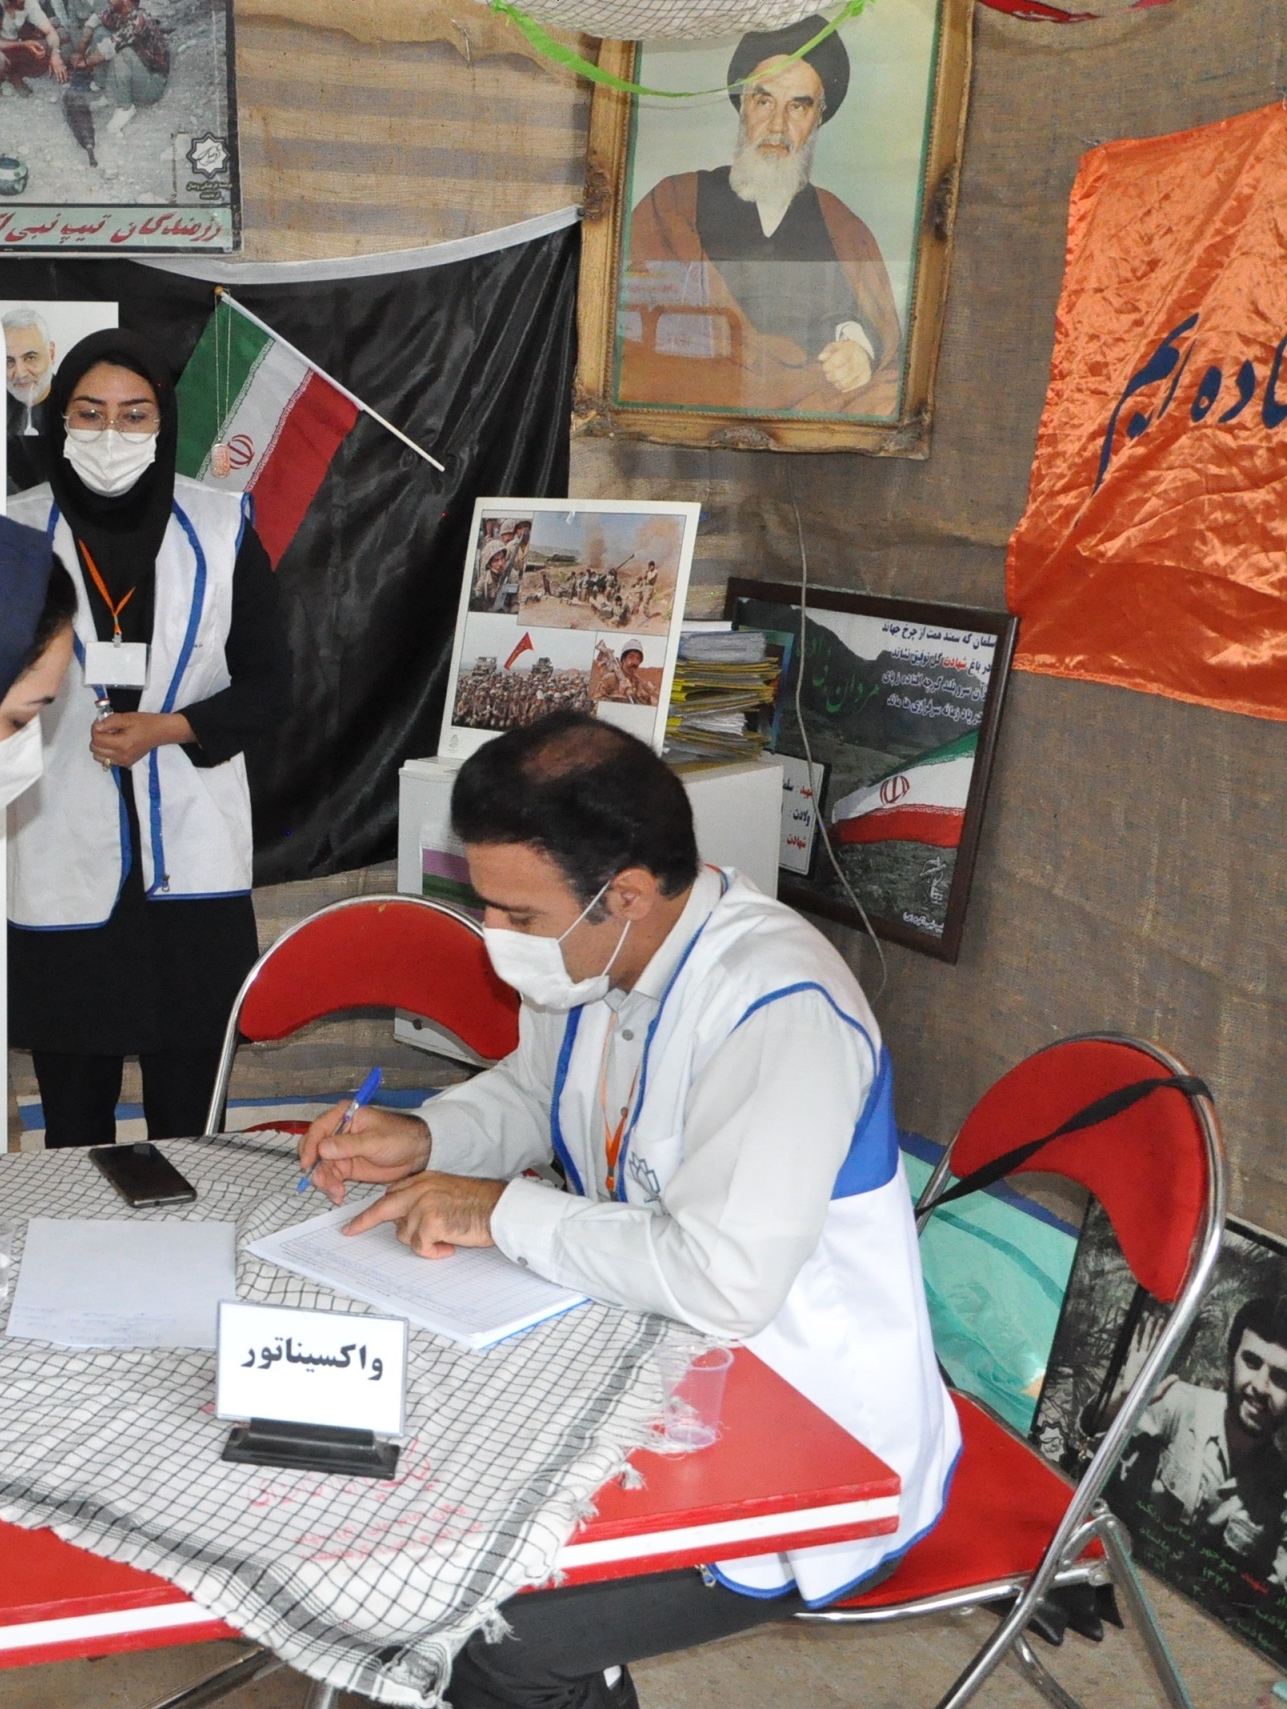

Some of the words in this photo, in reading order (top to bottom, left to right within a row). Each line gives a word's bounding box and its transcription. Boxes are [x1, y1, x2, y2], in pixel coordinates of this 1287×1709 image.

[5, 213, 62, 242] نبی
[59, 213, 112, 244] تیپ
[110, 211, 223, 243] رزمندگان
[902, 624, 917, 641] چرخ
[918, 626, 926, 640] از
[926, 630, 942, 640] همت
[962, 633, 973, 645] که
[973, 634, 996, 650] سلمان
[930, 651, 943, 668] گل
[942, 656, 968, 671] شهادت
[967, 659, 981, 676] باغ
[240, 1336, 384, 1381] واکسیناتور
